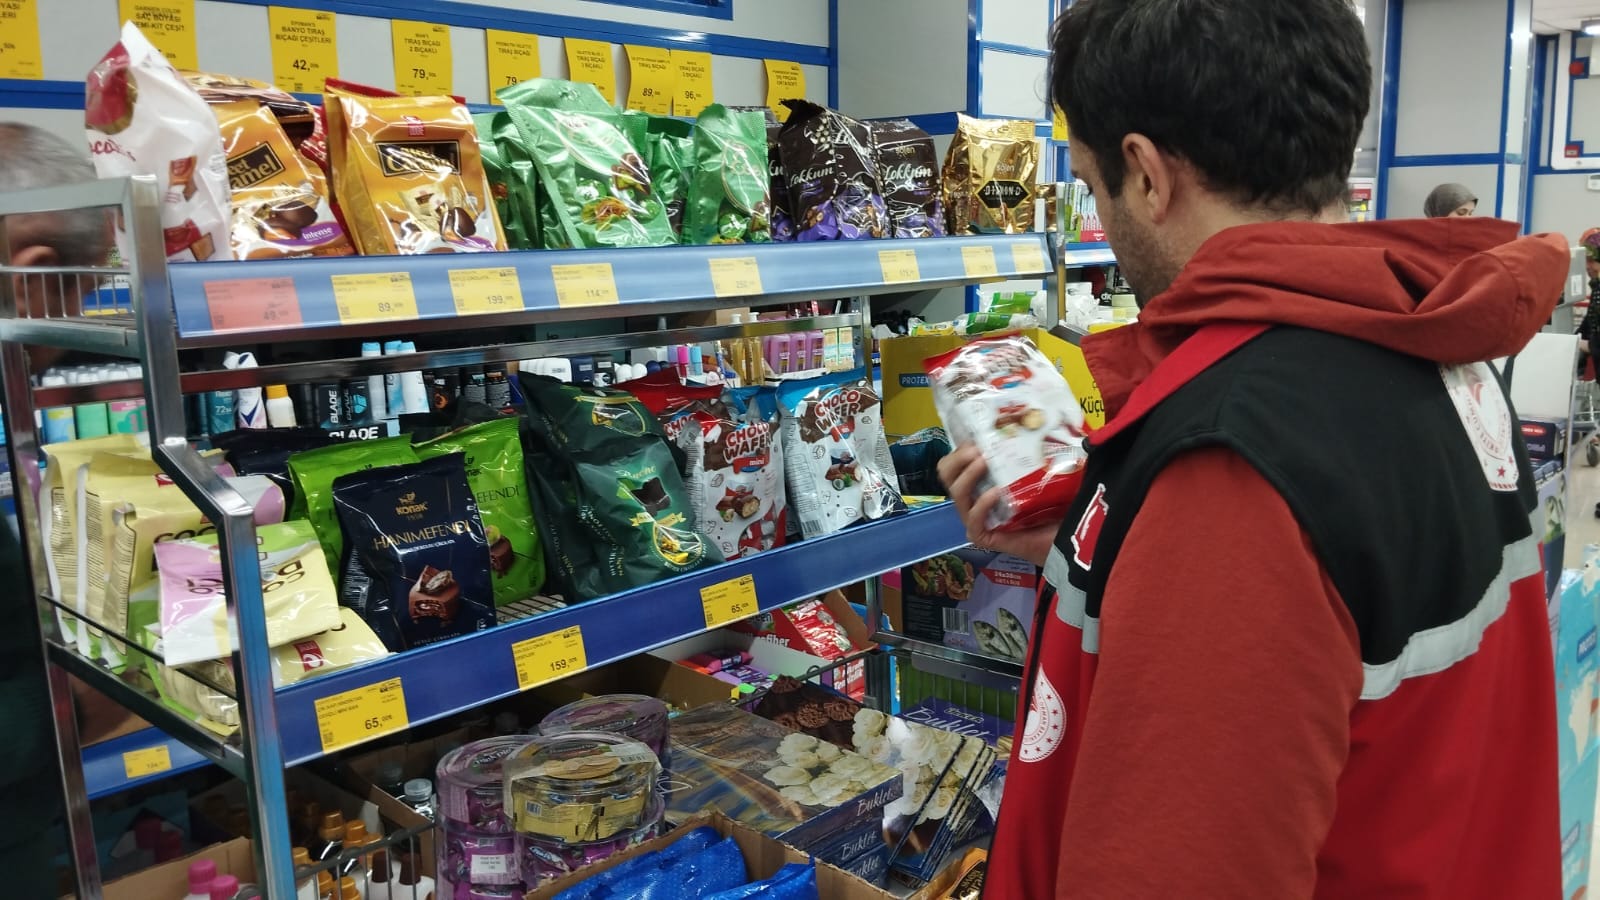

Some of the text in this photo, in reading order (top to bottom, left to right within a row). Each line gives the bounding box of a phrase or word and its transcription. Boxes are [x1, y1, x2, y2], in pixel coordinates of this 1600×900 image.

[227, 159, 250, 175] eet
[230, 153, 277, 189] amel
[328, 389, 338, 424] BLADE
[814, 390, 861, 418] CHOCO
[814, 403, 862, 432] WAFER
[722, 436, 772, 464] WAFER
[476, 484, 520, 504] EFENDİ
[856, 789, 894, 817] Buklet
[841, 831, 877, 860] Buklet
